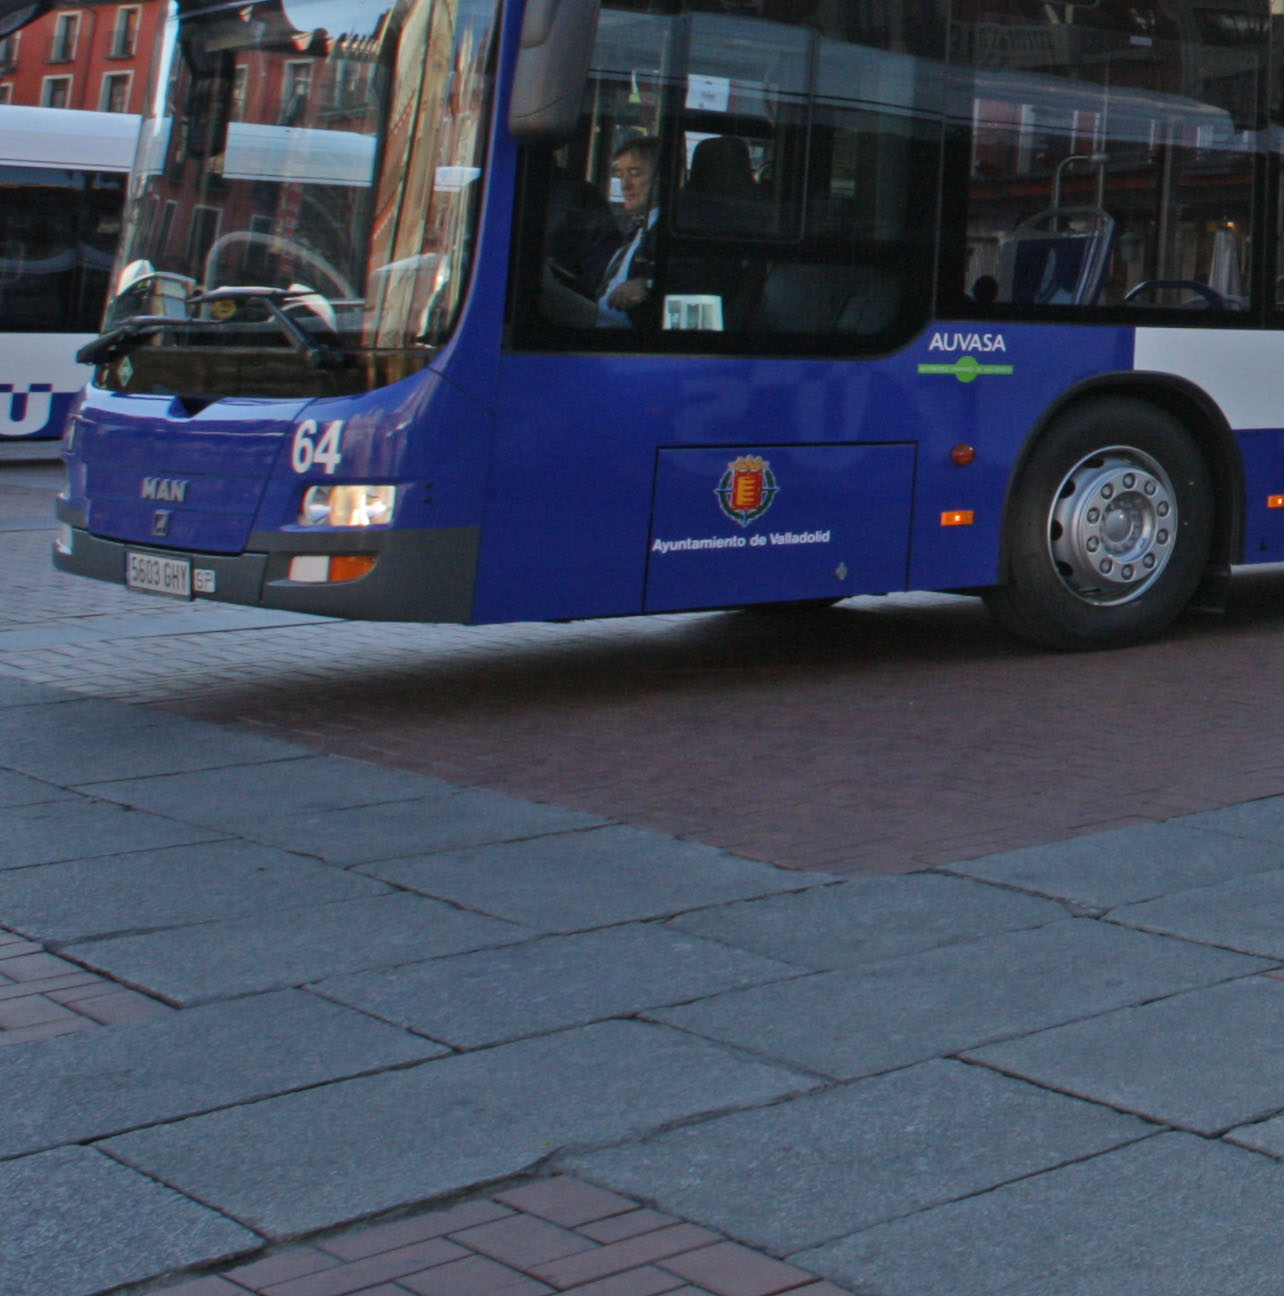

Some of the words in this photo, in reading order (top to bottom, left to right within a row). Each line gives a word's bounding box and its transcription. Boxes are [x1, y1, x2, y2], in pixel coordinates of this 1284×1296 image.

[928, 332, 1007, 352] AUVASA
[291, 418, 346, 475] 64
[141, 476, 190, 503] MAN
[652, 537, 747, 554] Ayuntamiento
[749, 534, 767, 547] de
[769, 530, 831, 546] Valladolid
[163, 562, 188, 595] GHY
[195, 572, 214, 591] SP
